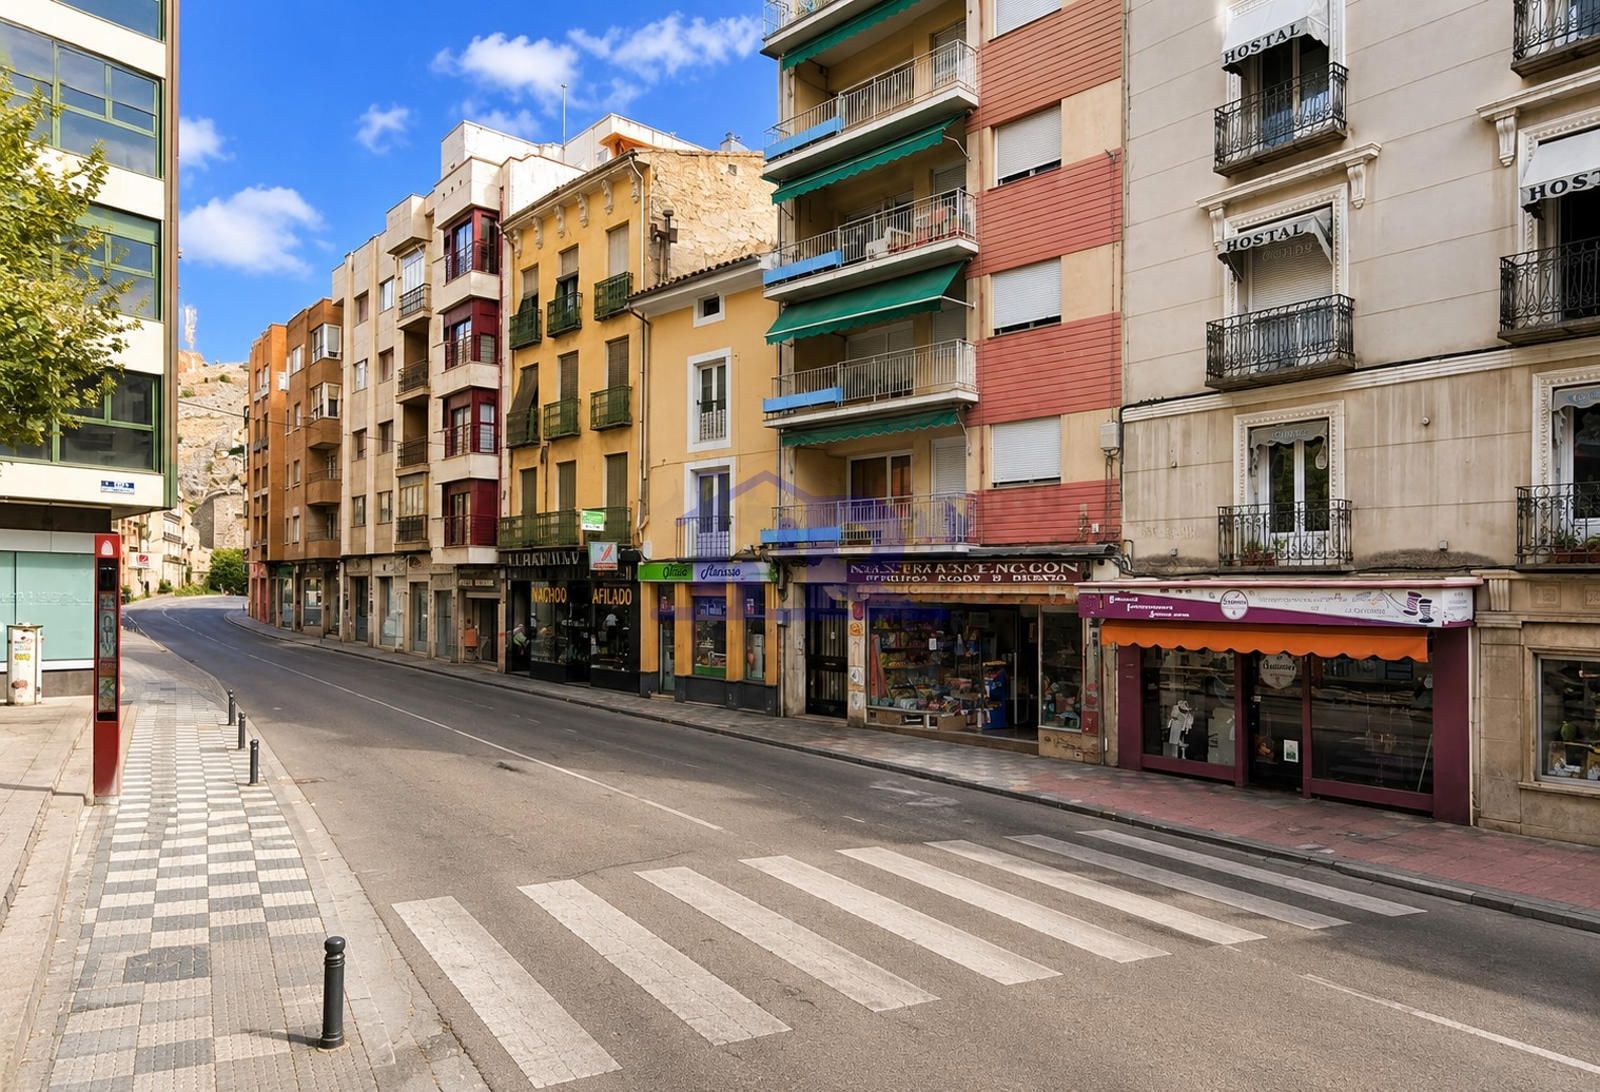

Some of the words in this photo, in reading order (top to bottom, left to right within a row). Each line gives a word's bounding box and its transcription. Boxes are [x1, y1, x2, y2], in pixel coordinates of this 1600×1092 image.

[1224, 24, 1301, 64] HOSTAL
[1226, 223, 1304, 252] HOSTAL
[591, 587, 632, 606] AFILADO
